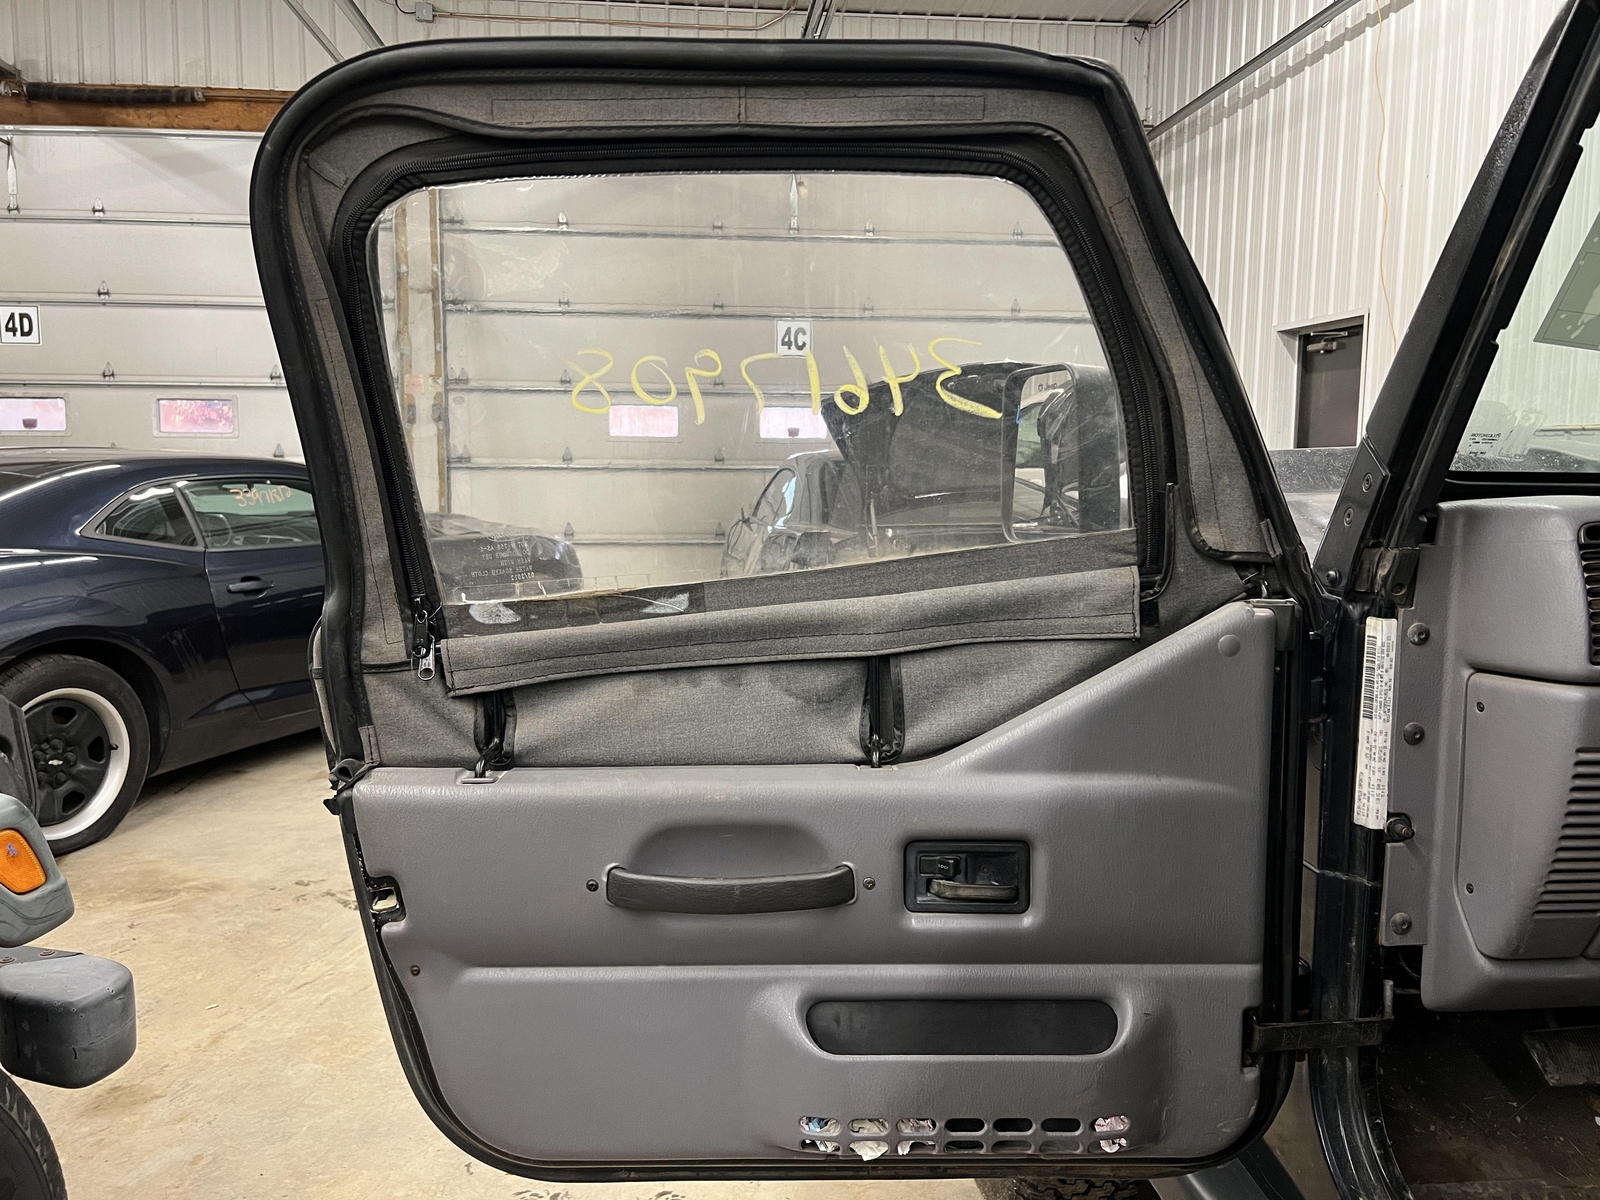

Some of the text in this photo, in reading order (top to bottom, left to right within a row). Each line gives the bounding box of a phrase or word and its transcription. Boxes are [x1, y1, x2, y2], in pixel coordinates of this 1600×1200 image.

[5, 312, 34, 338] 4D
[780, 326, 808, 351] 4C
[1044, 382, 1058, 391] Jeep
